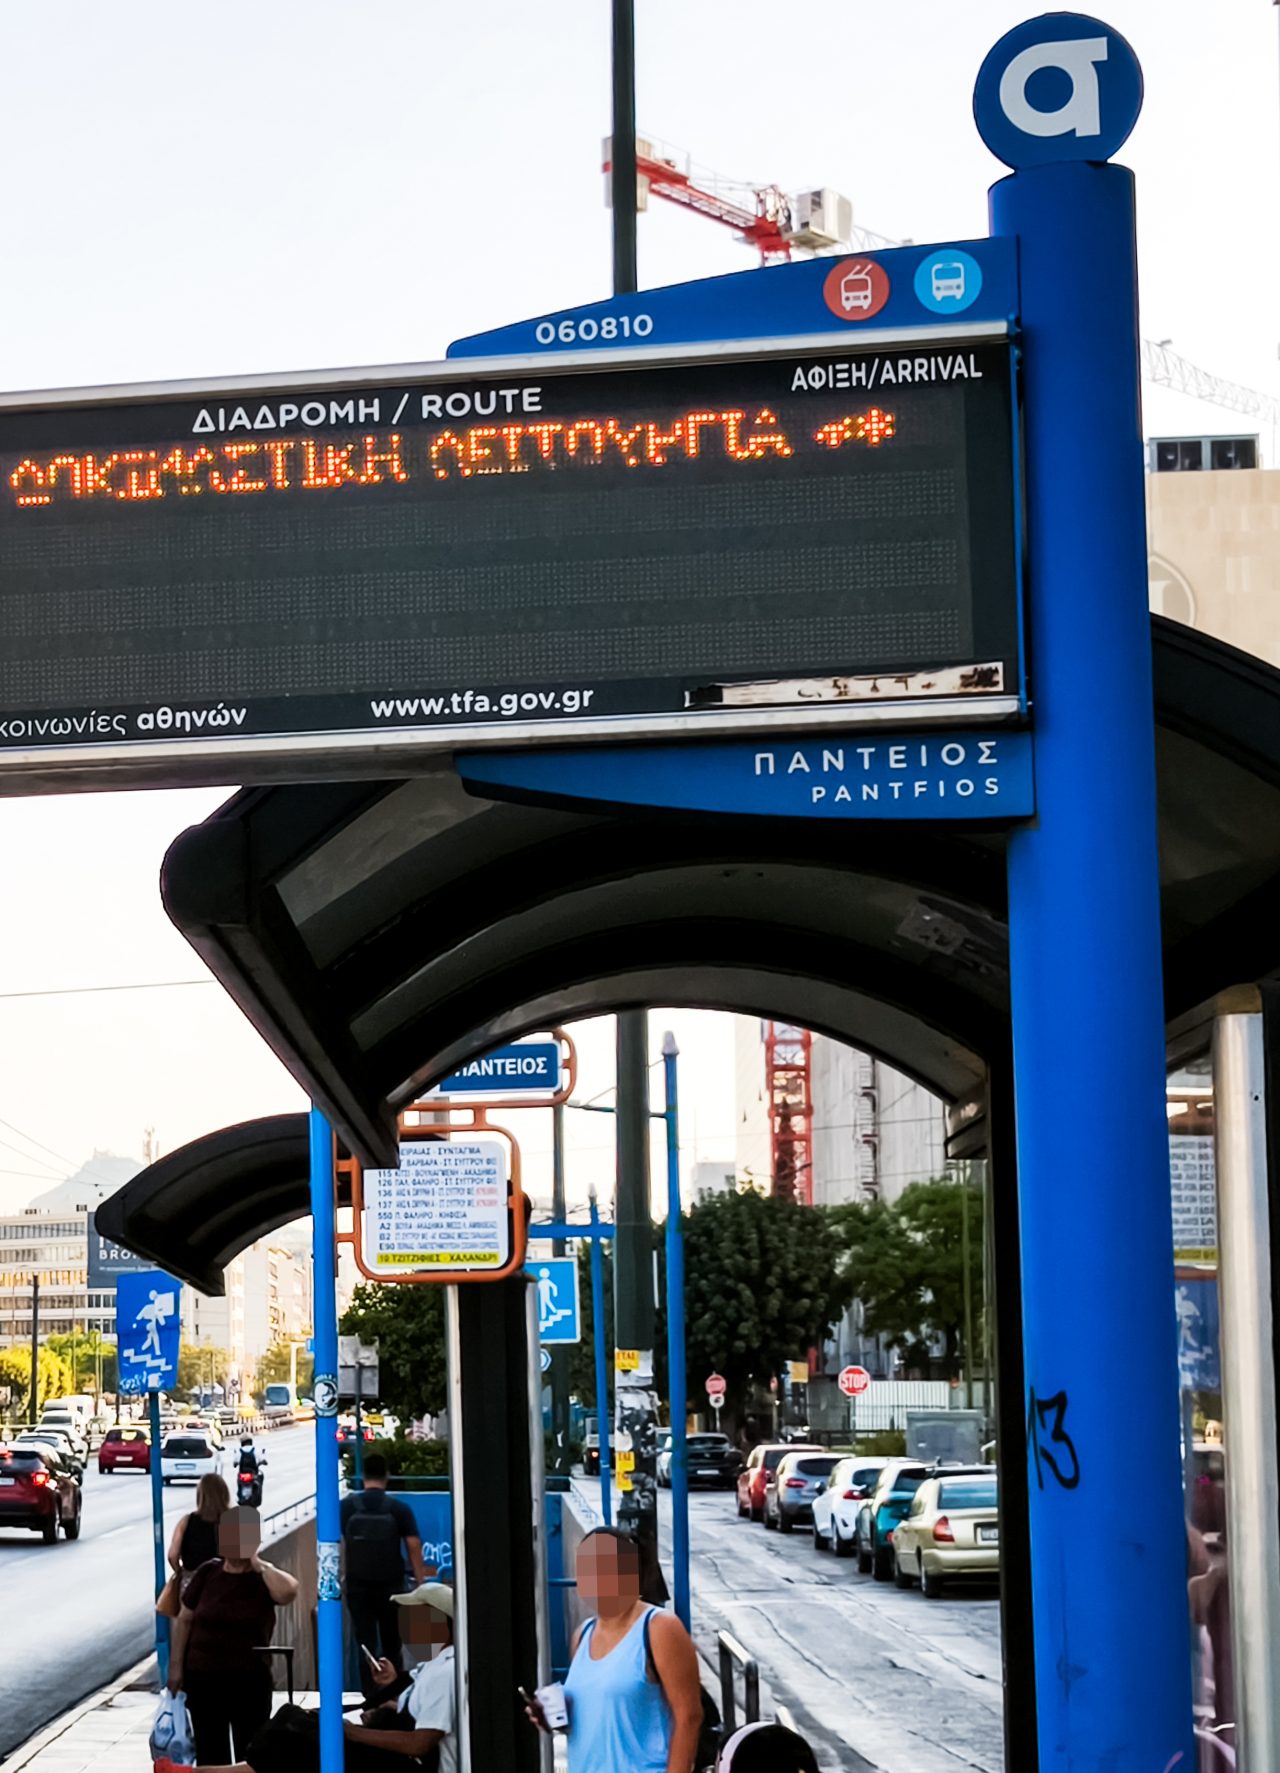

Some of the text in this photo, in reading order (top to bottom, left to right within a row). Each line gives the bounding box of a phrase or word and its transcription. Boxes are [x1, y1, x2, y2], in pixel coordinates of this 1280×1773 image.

[535, 314, 655, 345] 060810
[790, 354, 983, 392] ΑΦΙΞΗ/ARRIVAL
[192, 387, 543, 434] ΔΙΑΔΡΟΜΗ / ROUTE
[136, 702, 247, 733] αθηνών
[370, 687, 594, 719] www.tfa.gov.gr
[754, 741, 998, 775] ΠΑΝΤΕΙΟΣ
[455, 1056, 548, 1077] ΑΝΤΕΙΟΣ
[842, 1373, 868, 1389] STOP
